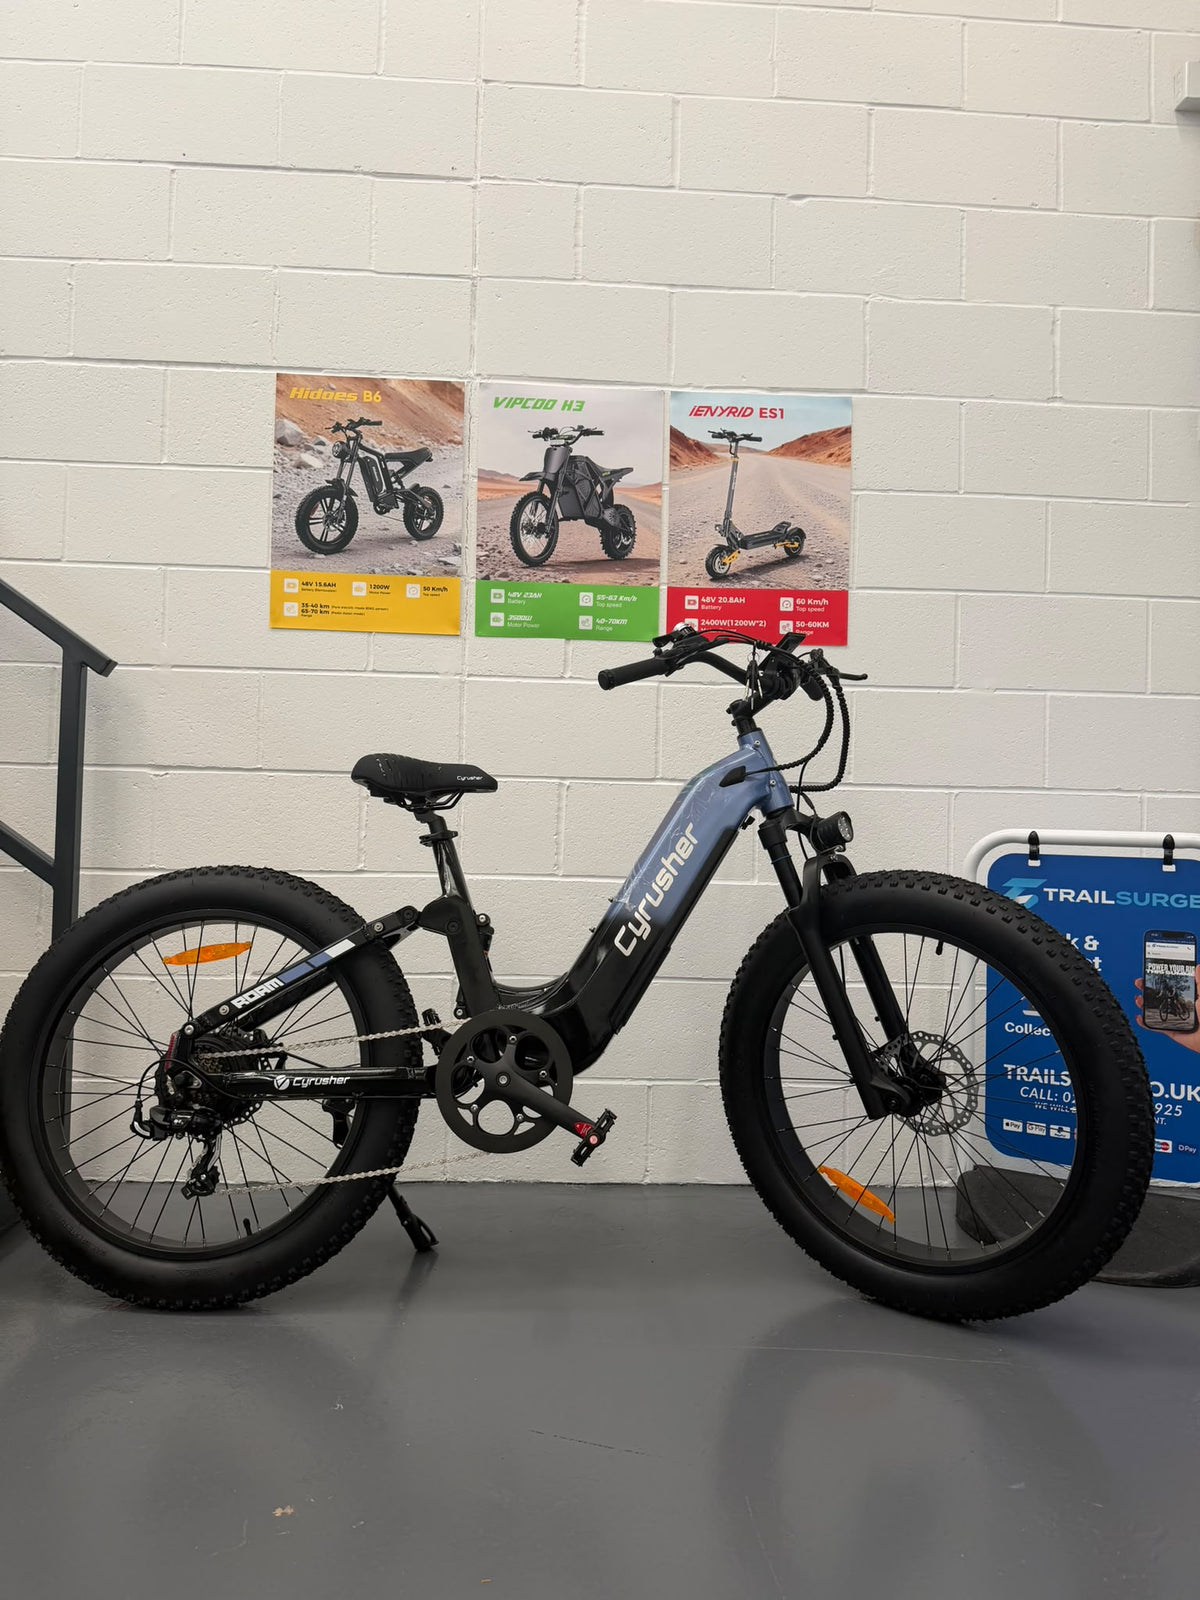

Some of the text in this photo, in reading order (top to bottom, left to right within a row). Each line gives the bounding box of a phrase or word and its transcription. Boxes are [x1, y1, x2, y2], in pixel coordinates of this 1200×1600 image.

[289, 387, 382, 403] Hidoes B6
[493, 396, 586, 412] VIPCOO H3
[759, 407, 784, 419] ES1
[718, 596, 746, 604] 20.8AH
[807, 598, 829, 606] Km/h
[796, 620, 829, 628] 50-60KM
[614, 822, 698, 957] Cyrusher
[1043, 888, 1200, 909] TRAILSURGE
[230, 977, 285, 1009] ROAM
[1004, 1021, 1051, 1037] Collec
[292, 1075, 351, 1089] Cyrusher
[1020, 1086, 1059, 1102] CALL:
